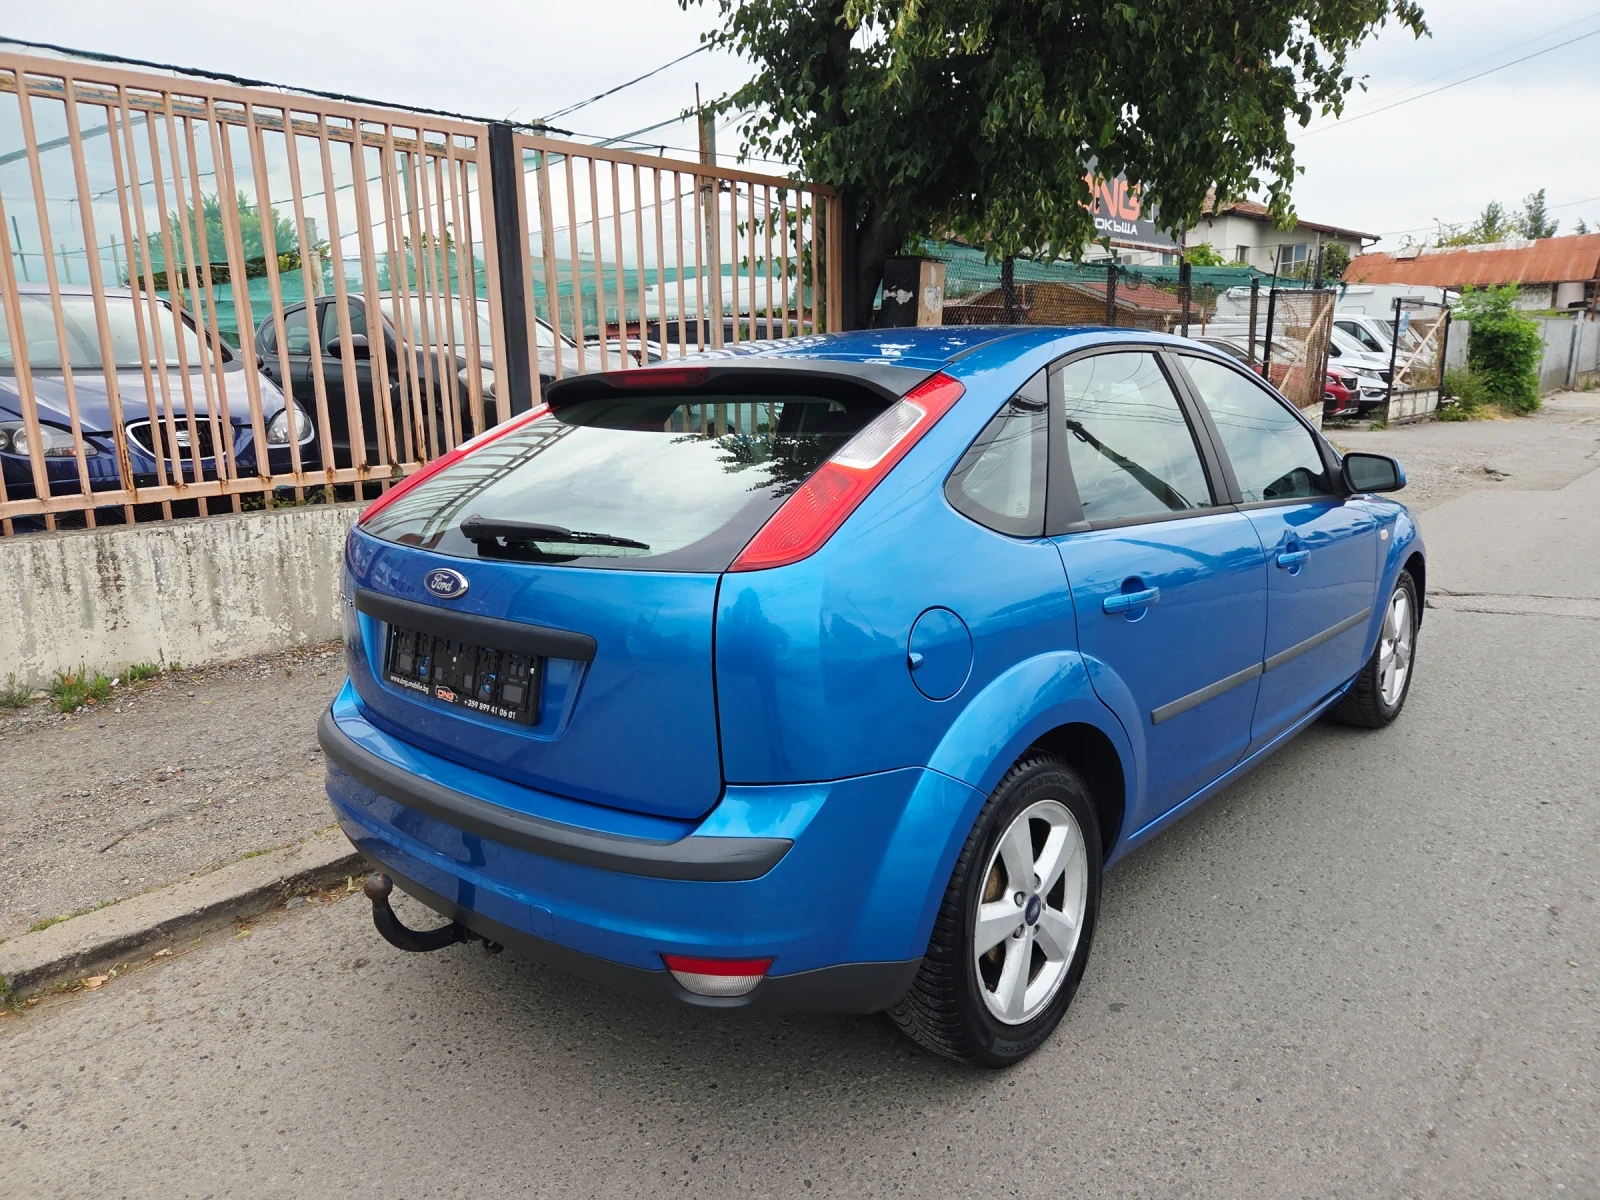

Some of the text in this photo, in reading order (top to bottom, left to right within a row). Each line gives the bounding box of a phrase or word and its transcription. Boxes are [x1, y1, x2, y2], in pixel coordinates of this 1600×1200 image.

[430, 573, 455, 592] Ford
[437, 688, 455, 702] DNG
[463, 699, 478, 709] +359
[478, 702, 490, 712] 899
[490, 705, 498, 715] 41
[499, 708, 508, 718] 06
[508, 711, 516, 720] 01
